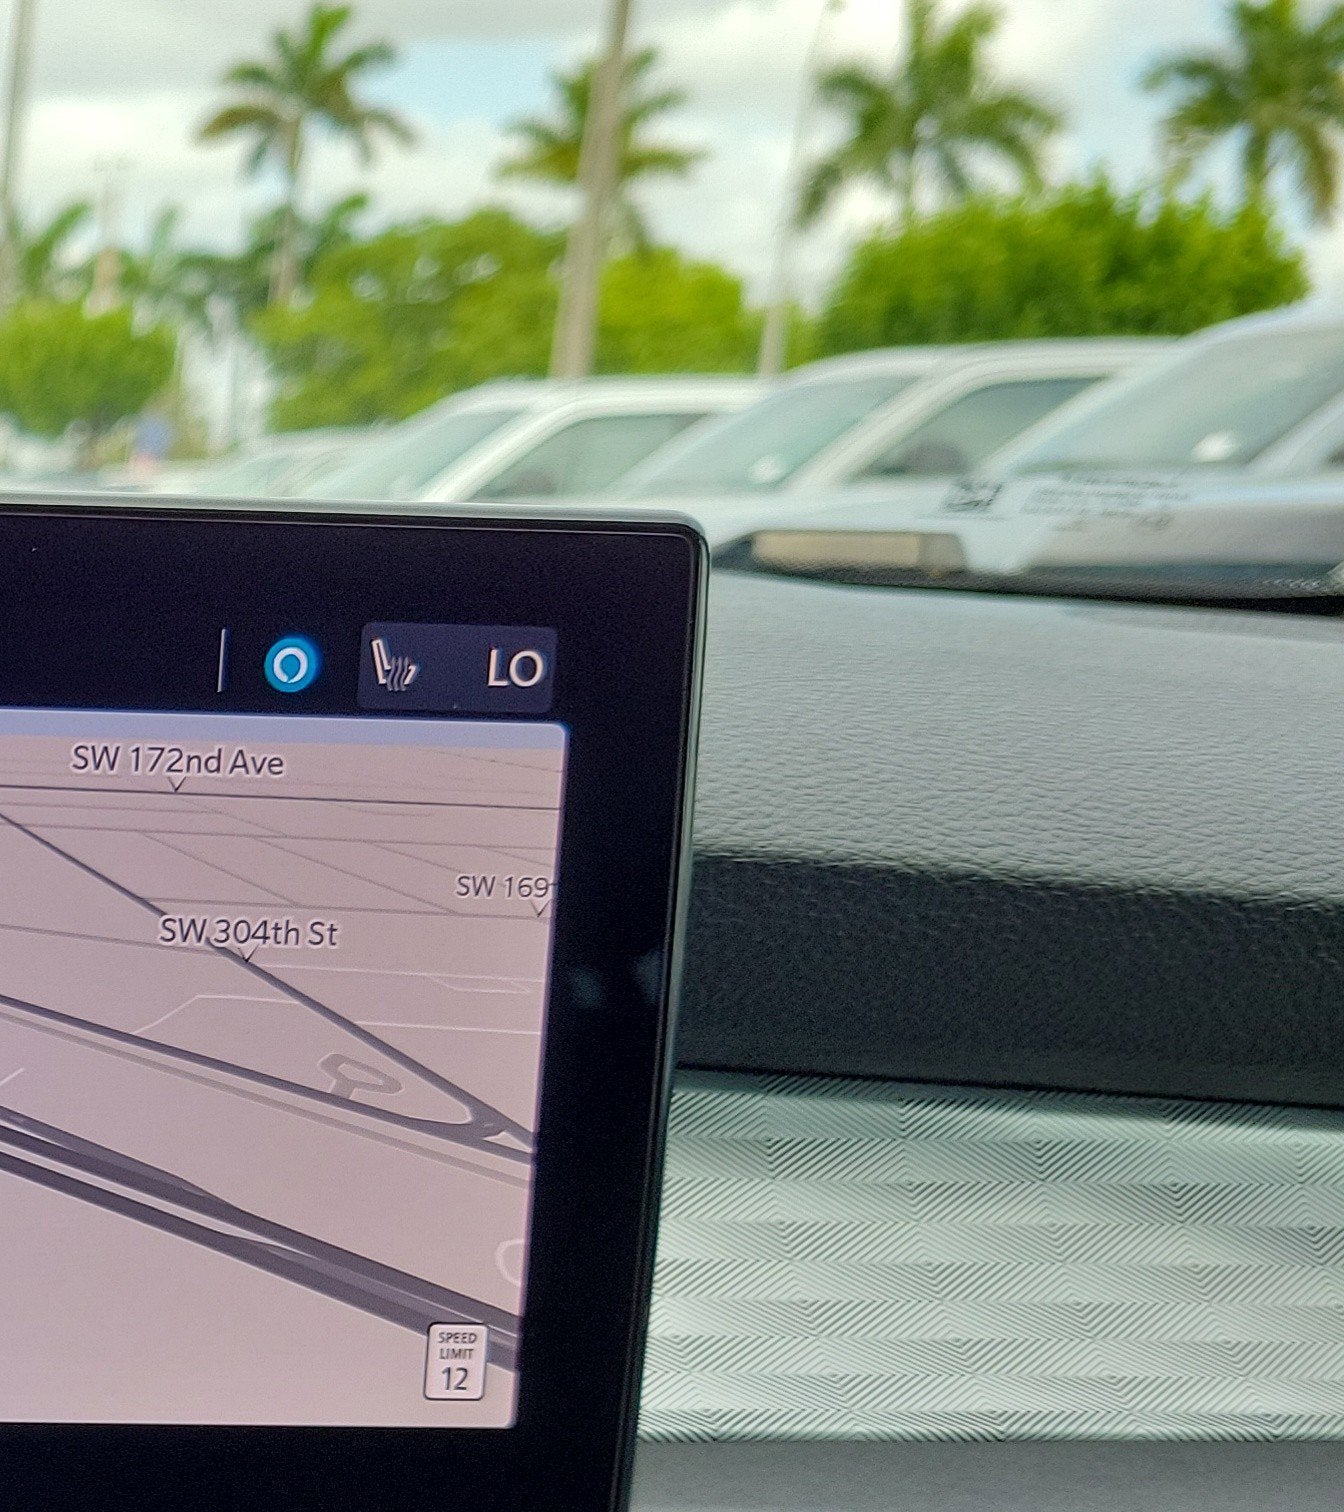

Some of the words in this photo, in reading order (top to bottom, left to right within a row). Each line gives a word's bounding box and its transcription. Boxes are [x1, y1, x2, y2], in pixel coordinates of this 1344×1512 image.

[487, 648, 546, 688] LO
[71, 745, 121, 772] SW
[130, 746, 222, 774] 172nd
[229, 751, 285, 776] Ave
[456, 875, 496, 897] SW
[505, 876, 549, 898] 169
[159, 917, 208, 943] SW
[213, 918, 301, 946] 304th
[308, 921, 339, 947] St
[438, 1332, 478, 1344] SPEED
[439, 1348, 475, 1361] LIMIT
[441, 1366, 469, 1391] 12
